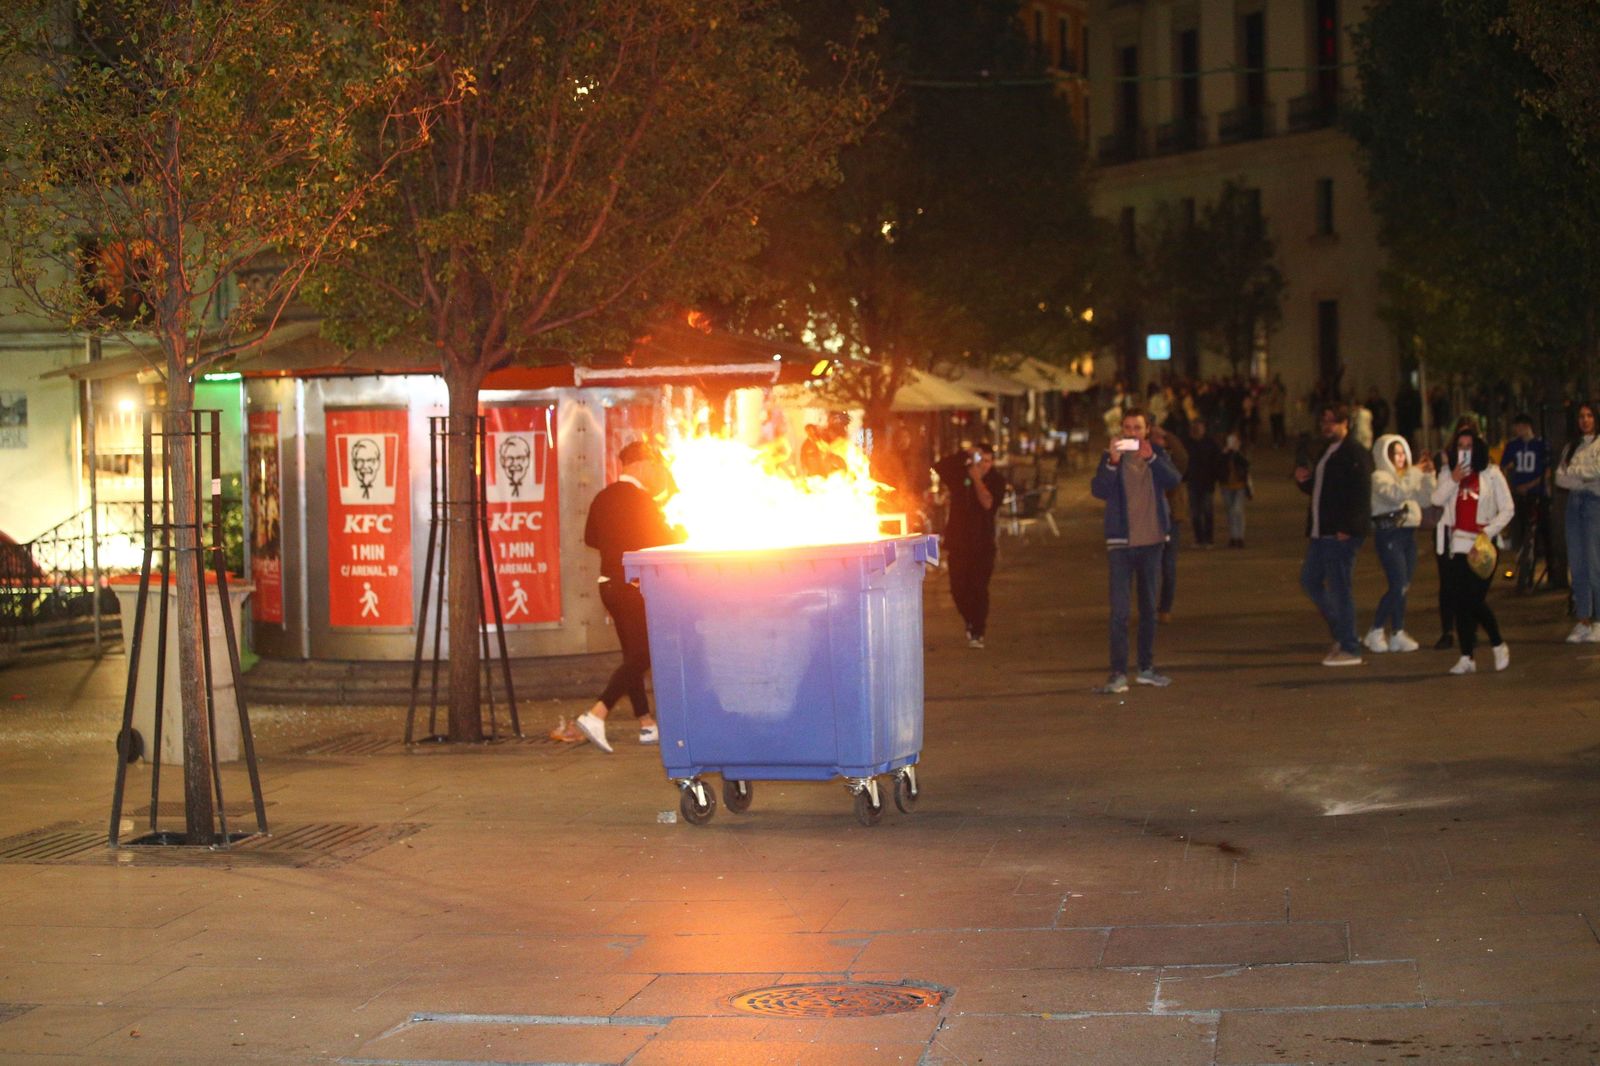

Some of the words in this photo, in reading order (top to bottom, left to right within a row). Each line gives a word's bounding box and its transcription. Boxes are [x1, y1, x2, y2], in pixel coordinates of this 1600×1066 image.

[1516, 452, 1535, 472] 10
[344, 514, 393, 533] KFC
[490, 512, 542, 531] KFC
[352, 544, 357, 560] 1
[360, 543, 385, 561] MIN
[500, 543, 506, 559] 1
[509, 541, 535, 559] MIN
